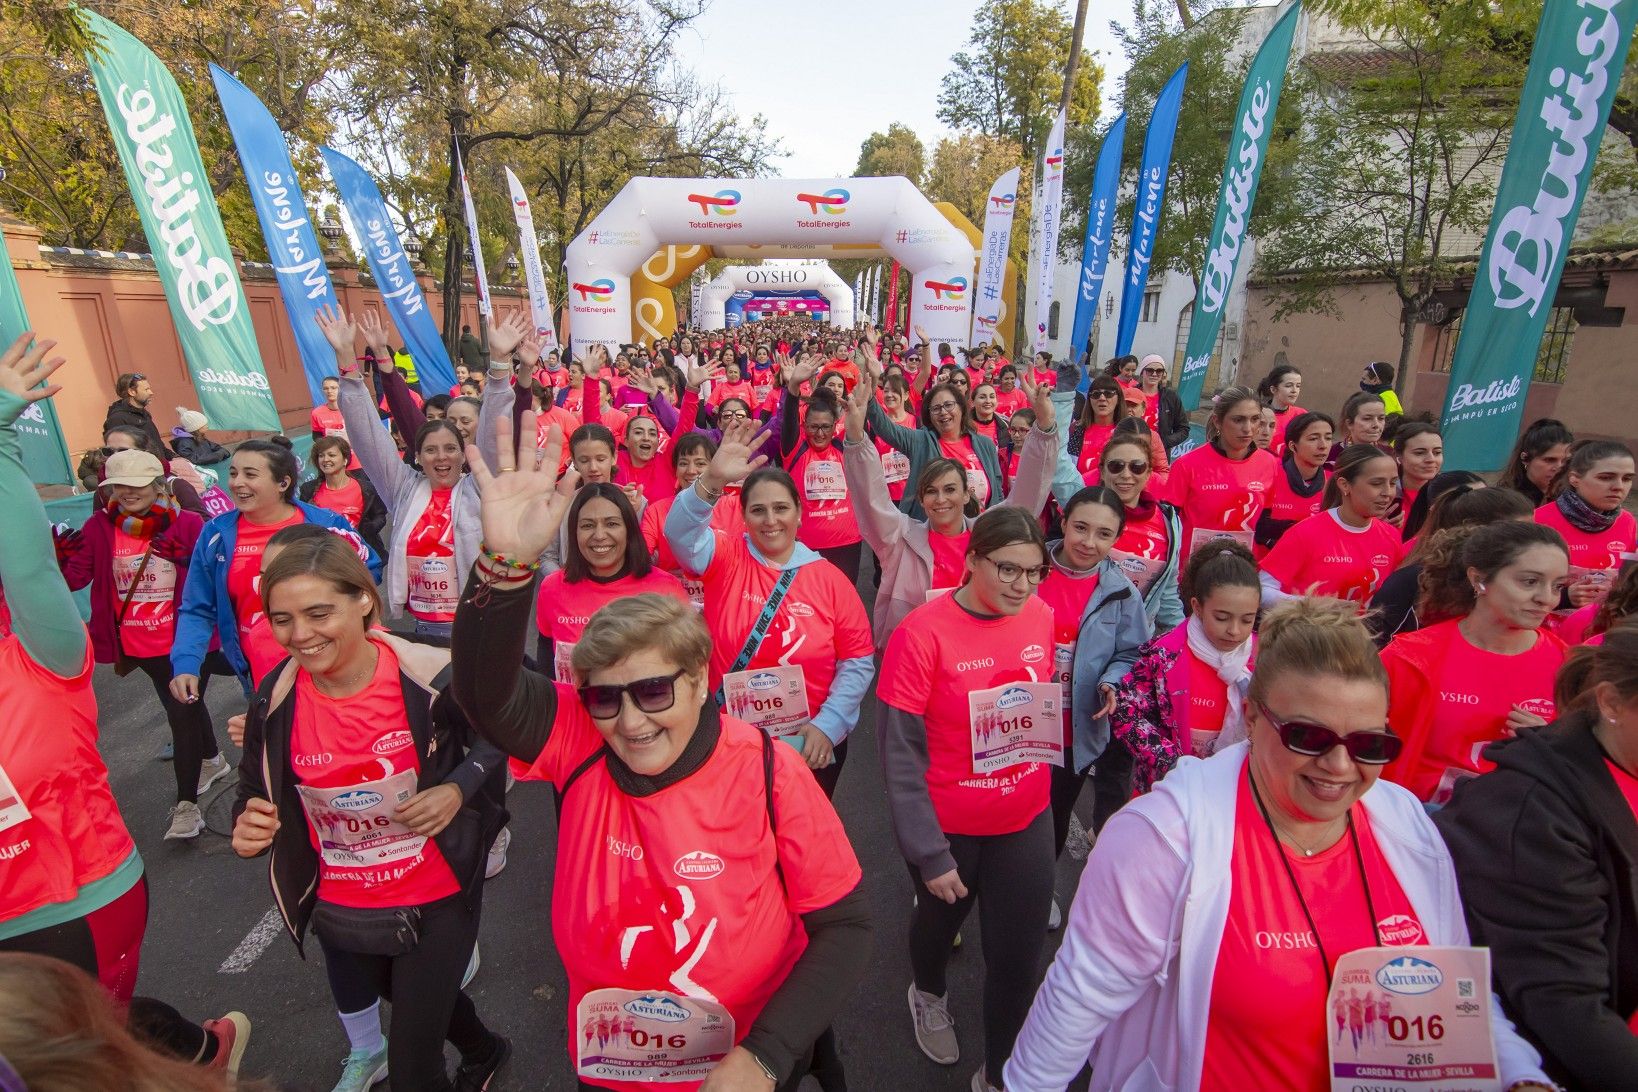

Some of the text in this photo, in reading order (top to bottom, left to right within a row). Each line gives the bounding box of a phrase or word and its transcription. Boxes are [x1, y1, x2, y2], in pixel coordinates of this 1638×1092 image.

[1489, 0, 1622, 318] Batis
[1202, 81, 1271, 316] Batiste
[688, 221, 743, 230] TotalEnergies
[796, 220, 851, 229] TotalEnergies
[1132, 167, 1161, 286] Marlene
[746, 269, 807, 284] OYSHO
[573, 305, 617, 315] TotalEnergies
[923, 304, 966, 312] TotalEnergies
[1450, 374, 1521, 412] Batiste
[819, 476, 835, 484] 016
[1202, 483, 1229, 491] OYSHO
[1324, 556, 1353, 564] OYSHO
[424, 580, 448, 591] 016
[557, 616, 590, 625] OYSHO
[957, 657, 995, 673] OYSHO
[754, 697, 783, 711] 016
[1440, 691, 1480, 705] YSHO
[1001, 715, 1033, 734] 016
[983, 756, 1010, 768] OYSHO
[334, 795, 381, 810] ASTURIANA
[347, 815, 390, 833] 016
[361, 831, 383, 841] 4061
[0, 839, 31, 860] UJER
[387, 842, 422, 856] Santander
[607, 834, 644, 861] YSHO
[679, 862, 720, 874] ASTURIANA
[1341, 975, 1372, 985] SUMA
[1383, 970, 1440, 986] ASTURIANA
[589, 1005, 620, 1014] SUMA
[630, 1002, 686, 1019] ASTURIANA
[1387, 1014, 1445, 1041] 016
[630, 1029, 687, 1049] 016
[600, 1057, 632, 1066] CARRERA
[684, 1056, 712, 1065] SEVILLA
[647, 1053, 668, 1061] 989
[1407, 1053, 1434, 1065] 2616
[596, 1066, 712, 1077] OYSHO Santande
[1356, 1066, 1393, 1077] CARRERA
[1394, 1068, 1406, 1078] DE
[1408, 1069, 1419, 1079] LA
[1446, 1066, 1474, 1077] SEVILLA
